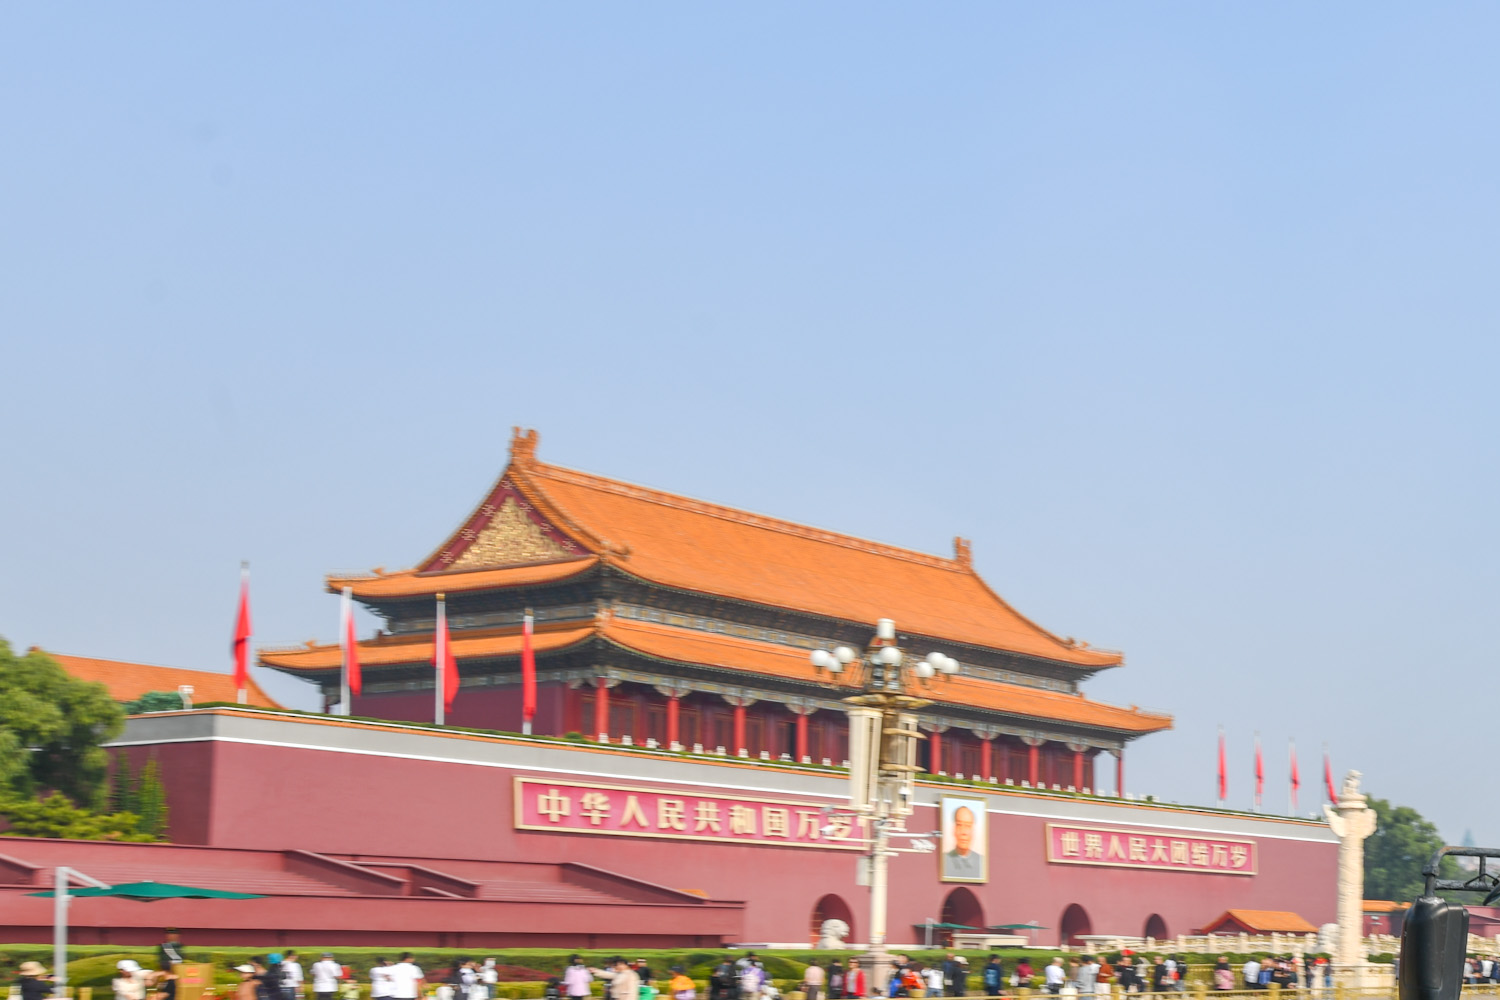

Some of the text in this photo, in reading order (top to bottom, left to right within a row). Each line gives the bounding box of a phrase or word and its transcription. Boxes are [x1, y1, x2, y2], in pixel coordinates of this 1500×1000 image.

[537, 788, 854, 840] 中华人民共和国万岁
[1060, 831, 1248, 869] 世界人民大团结万岁
